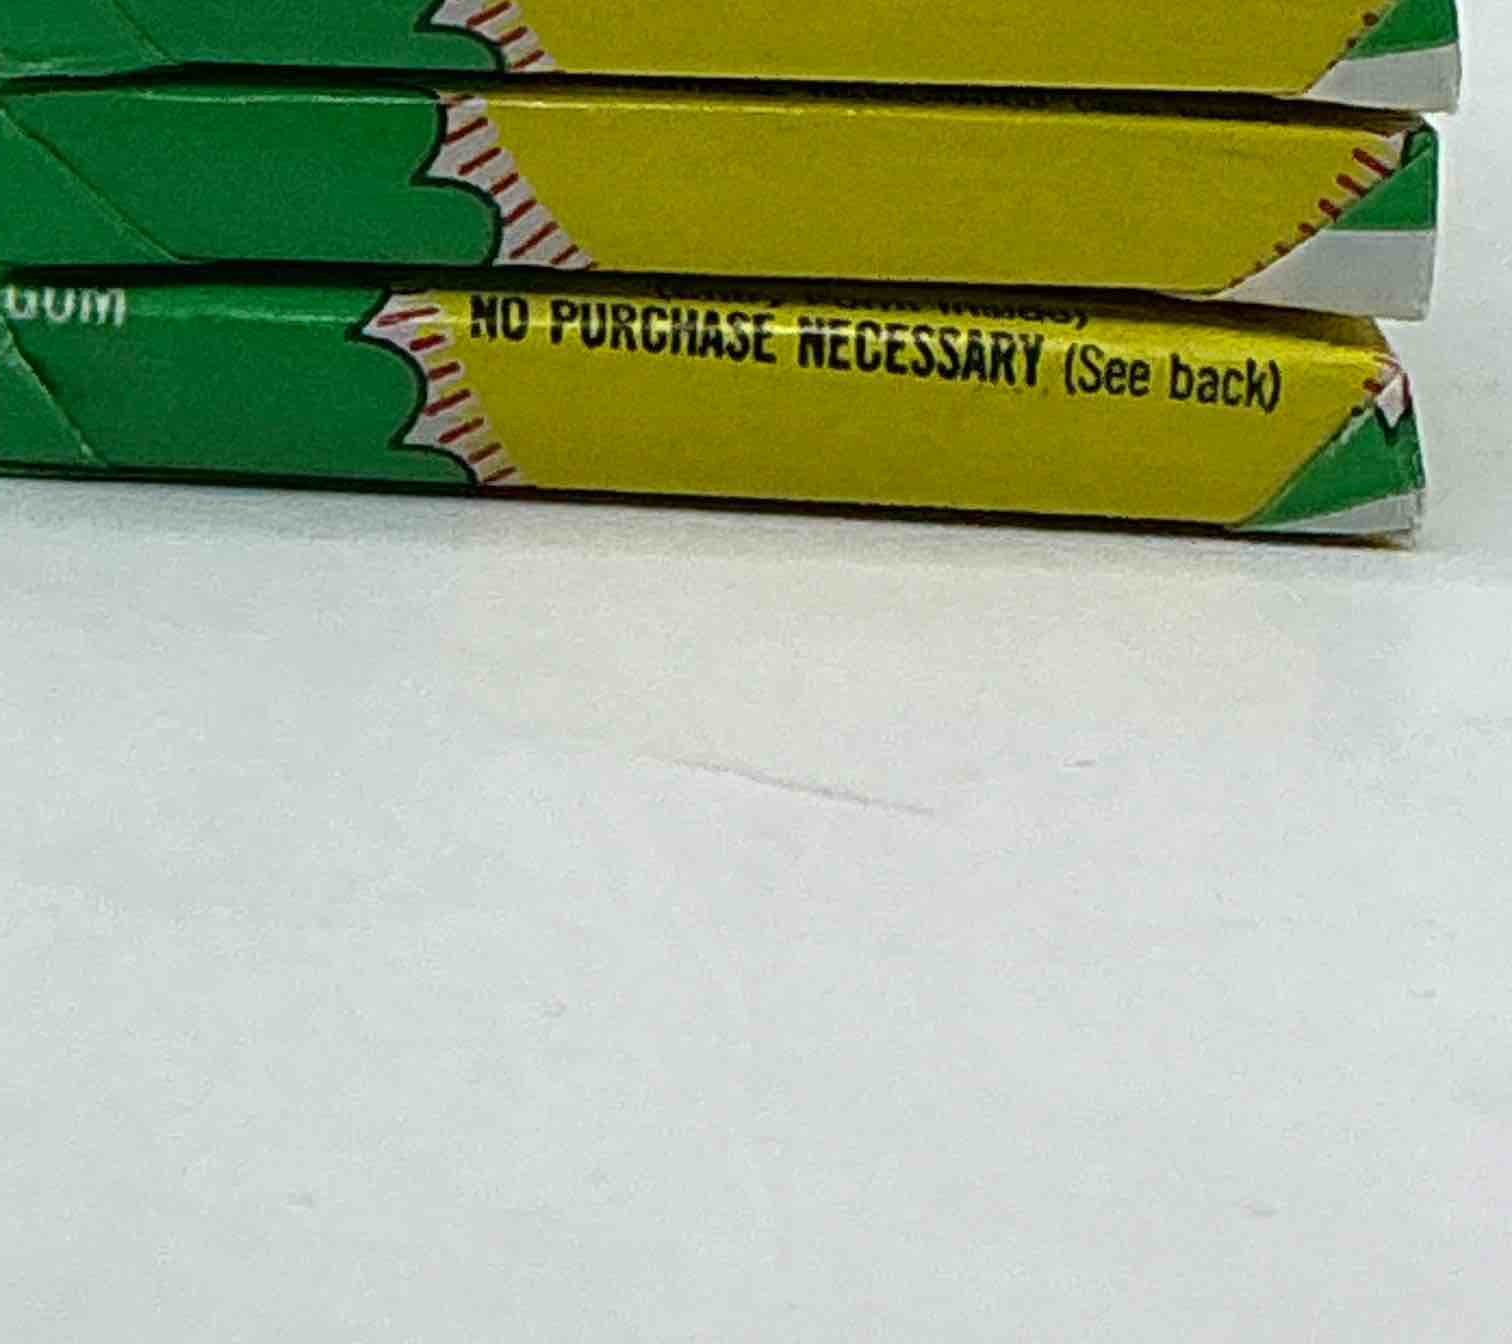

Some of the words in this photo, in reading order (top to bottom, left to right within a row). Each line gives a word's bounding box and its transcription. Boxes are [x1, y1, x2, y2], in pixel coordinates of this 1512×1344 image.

[470, 294, 530, 341] NO
[549, 298, 777, 364] PURCHASE
[797, 315, 1044, 387] NECESSARY
[1064, 342, 1152, 396] (See
[1169, 352, 1282, 415] back)
